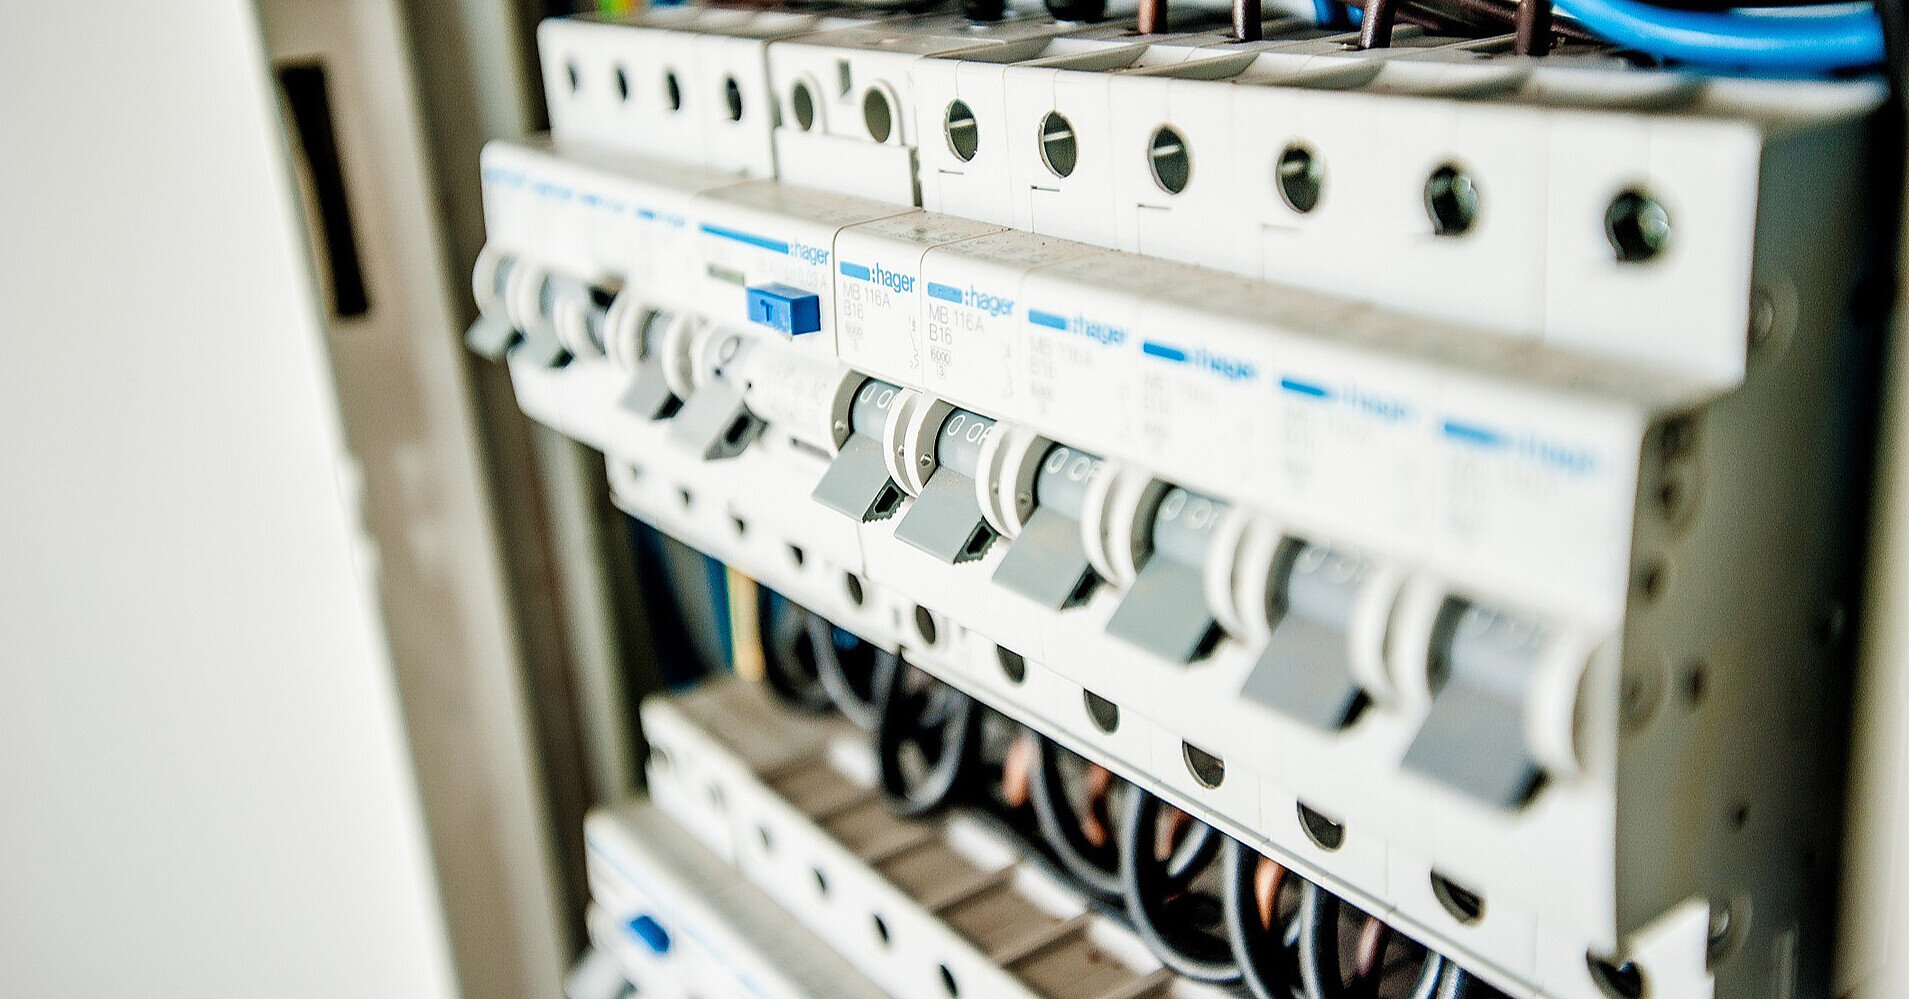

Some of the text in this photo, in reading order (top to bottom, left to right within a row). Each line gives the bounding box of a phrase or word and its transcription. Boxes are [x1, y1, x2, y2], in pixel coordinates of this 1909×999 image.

[929, 303, 985, 334] MB 116A
[929, 323, 953, 346] B16
[876, 389, 896, 411] O
